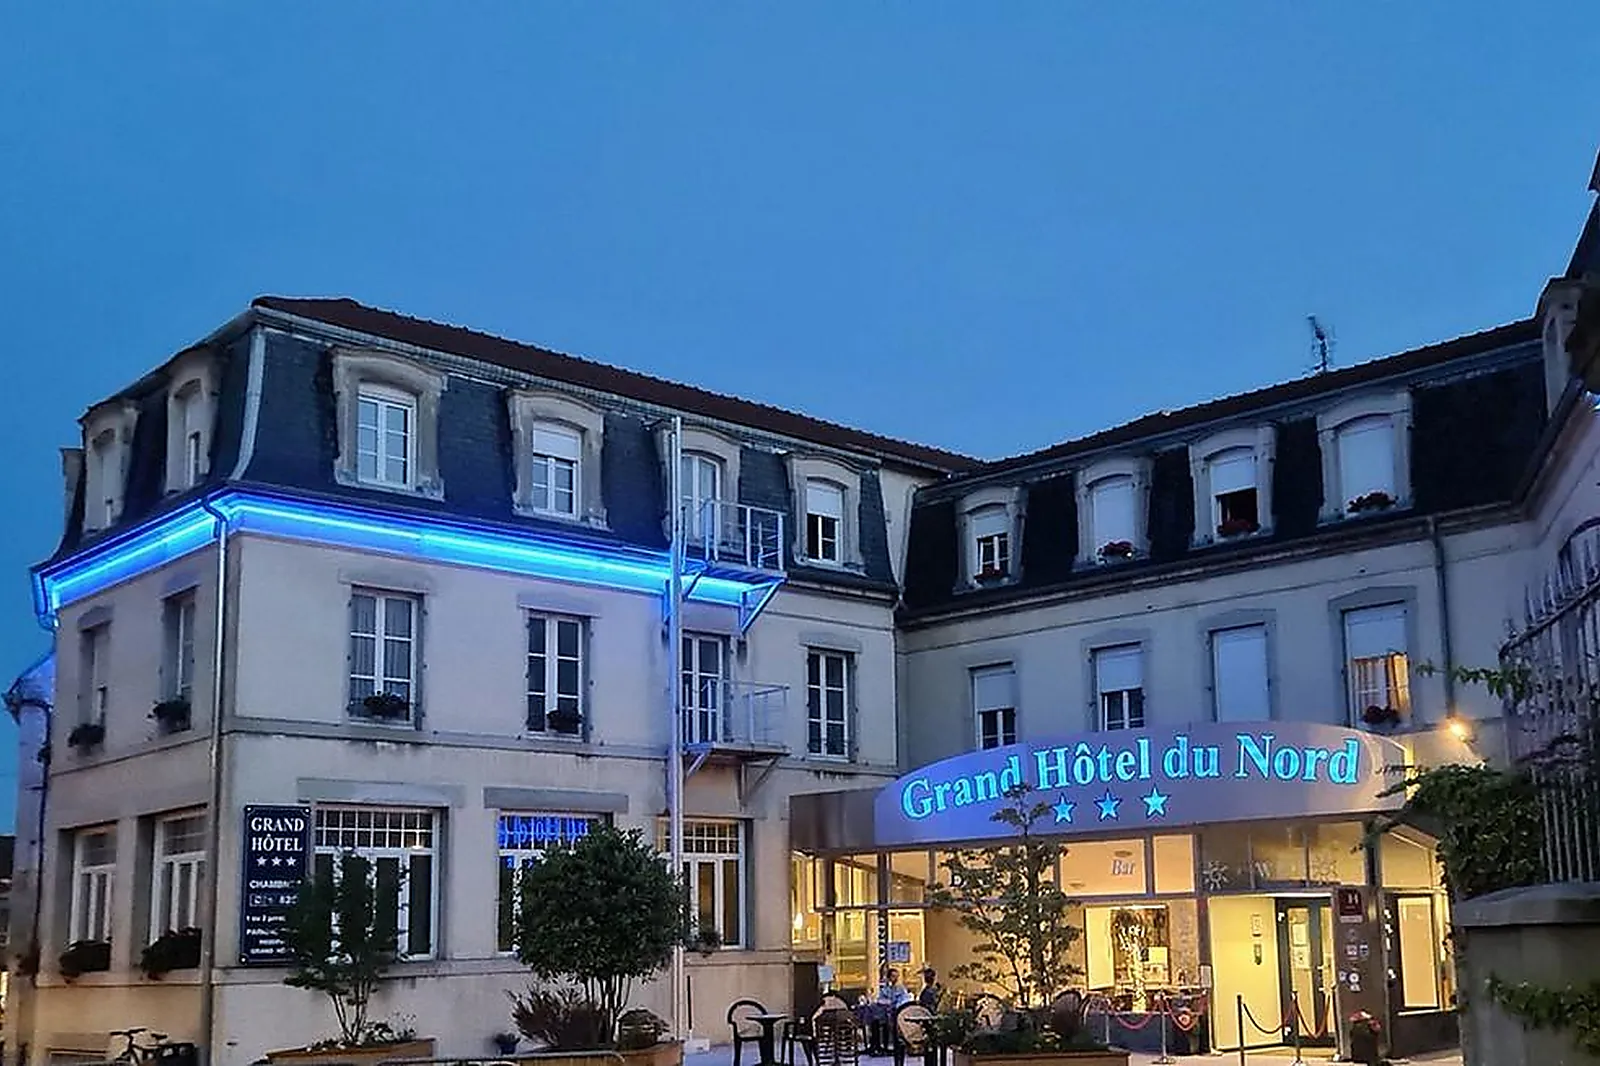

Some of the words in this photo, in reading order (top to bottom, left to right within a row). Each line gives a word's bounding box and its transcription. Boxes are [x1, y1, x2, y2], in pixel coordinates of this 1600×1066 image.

[902, 755, 1022, 819] Grand
[1033, 738, 1151, 790] Hôtel
[1163, 736, 1221, 779] du
[1235, 734, 1359, 785] Nord
[251, 817, 304, 832] GRAND
[252, 833, 303, 852] HÔTEL
